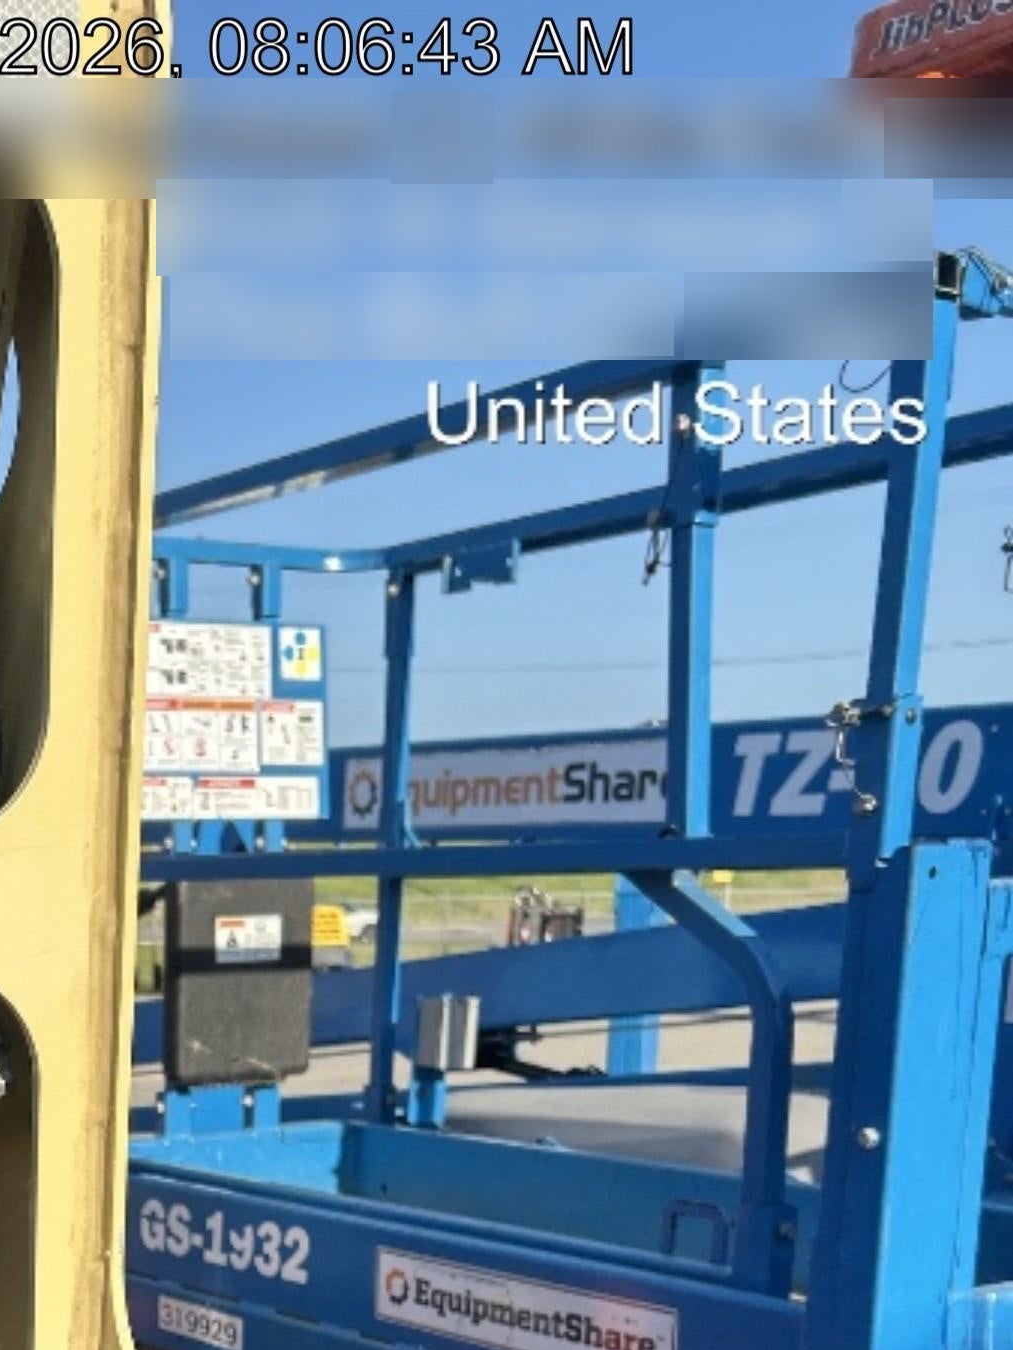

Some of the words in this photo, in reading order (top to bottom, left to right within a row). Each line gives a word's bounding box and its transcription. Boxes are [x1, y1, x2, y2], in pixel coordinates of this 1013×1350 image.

[732, 719, 984, 818] TZ-0
[140, 1198, 310, 1286] GS-1932
[161, 1303, 238, 1346] 319929
